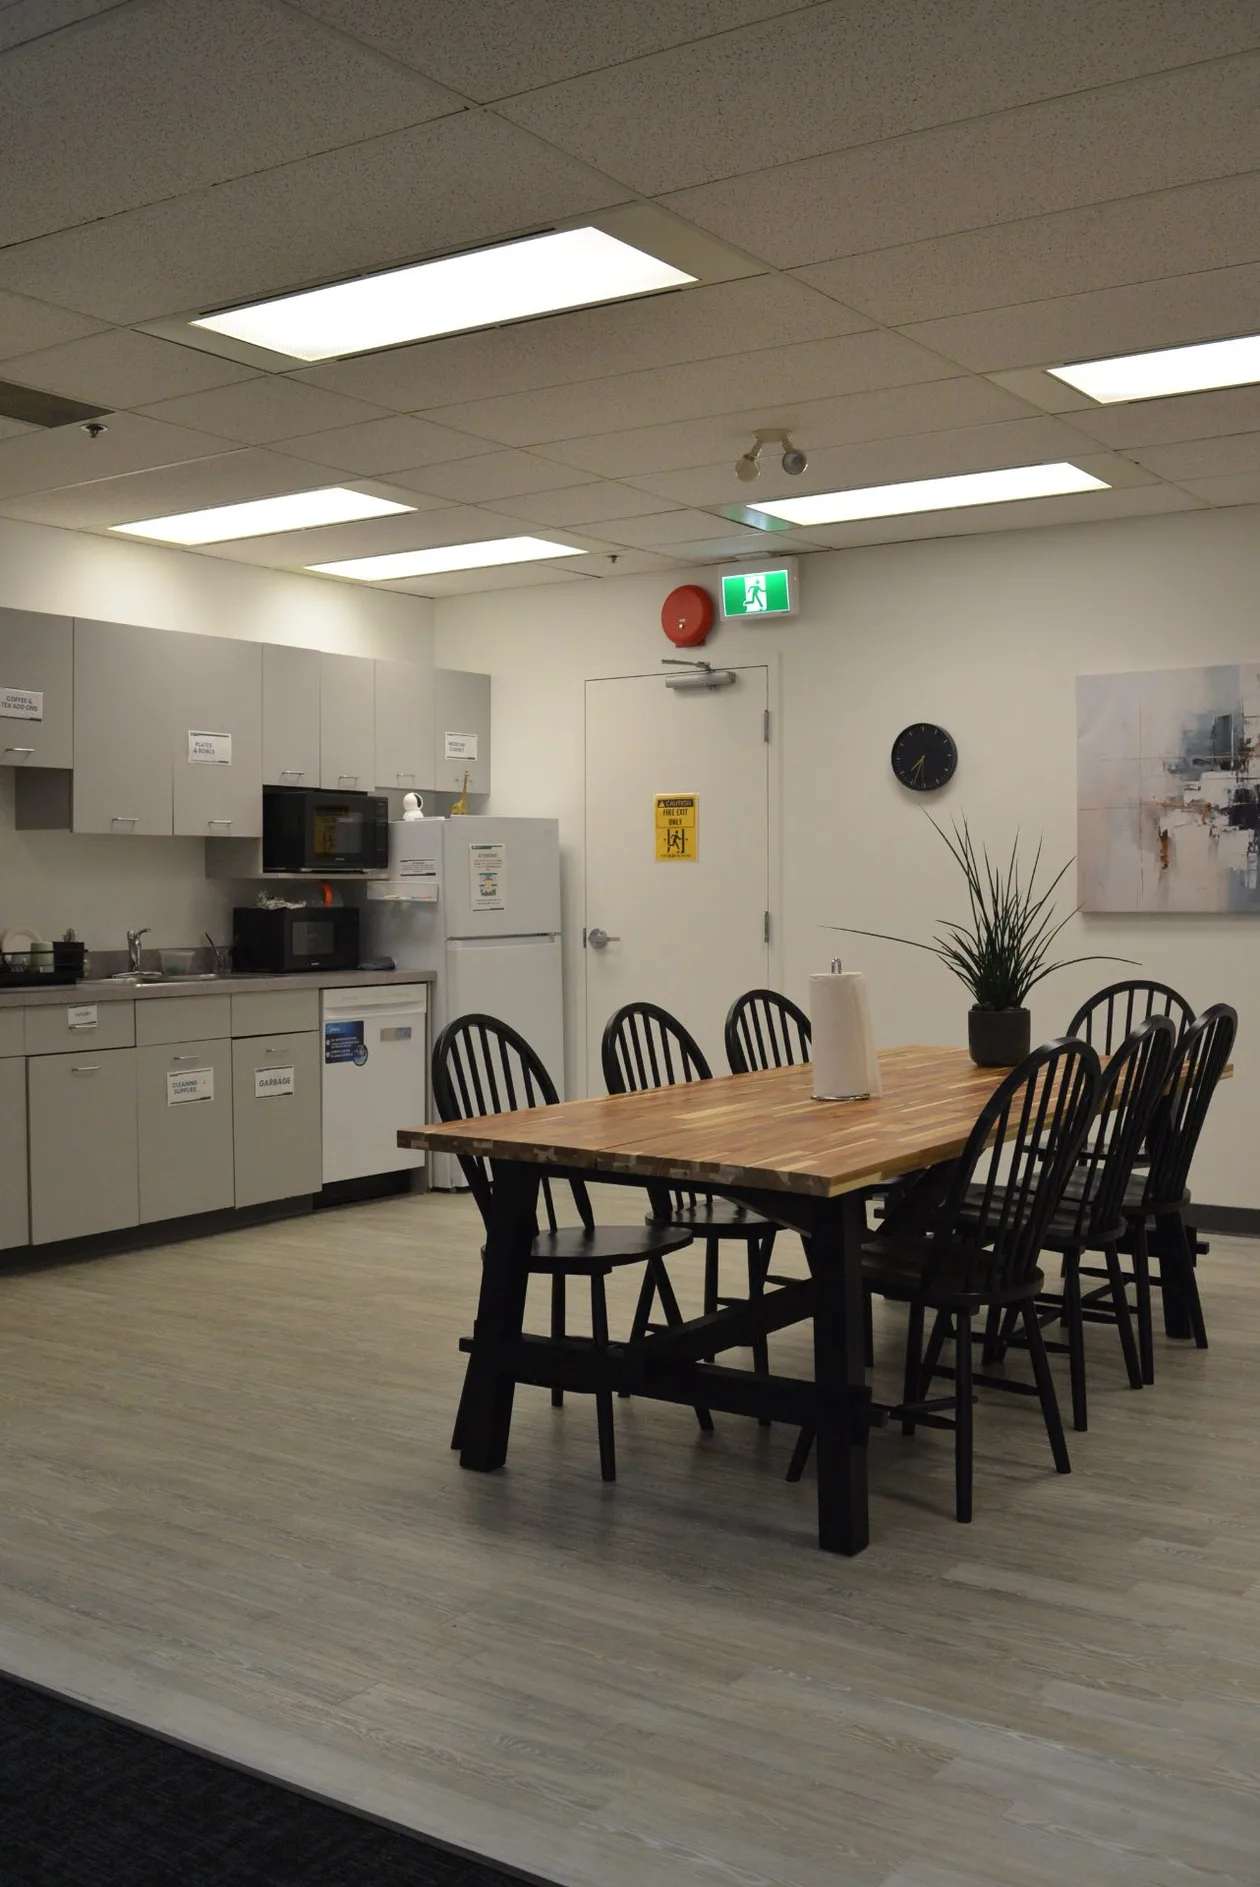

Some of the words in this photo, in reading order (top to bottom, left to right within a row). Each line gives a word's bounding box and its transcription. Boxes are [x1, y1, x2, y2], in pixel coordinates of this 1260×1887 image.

[6, 696, 27, 704] COFFEE
[676, 808, 688, 816] EXIT
[172, 1080, 198, 1088] CLEANING
[259, 1077, 291, 1087] GARBAGE
[173, 1087, 196, 1095] SUPPLIES
